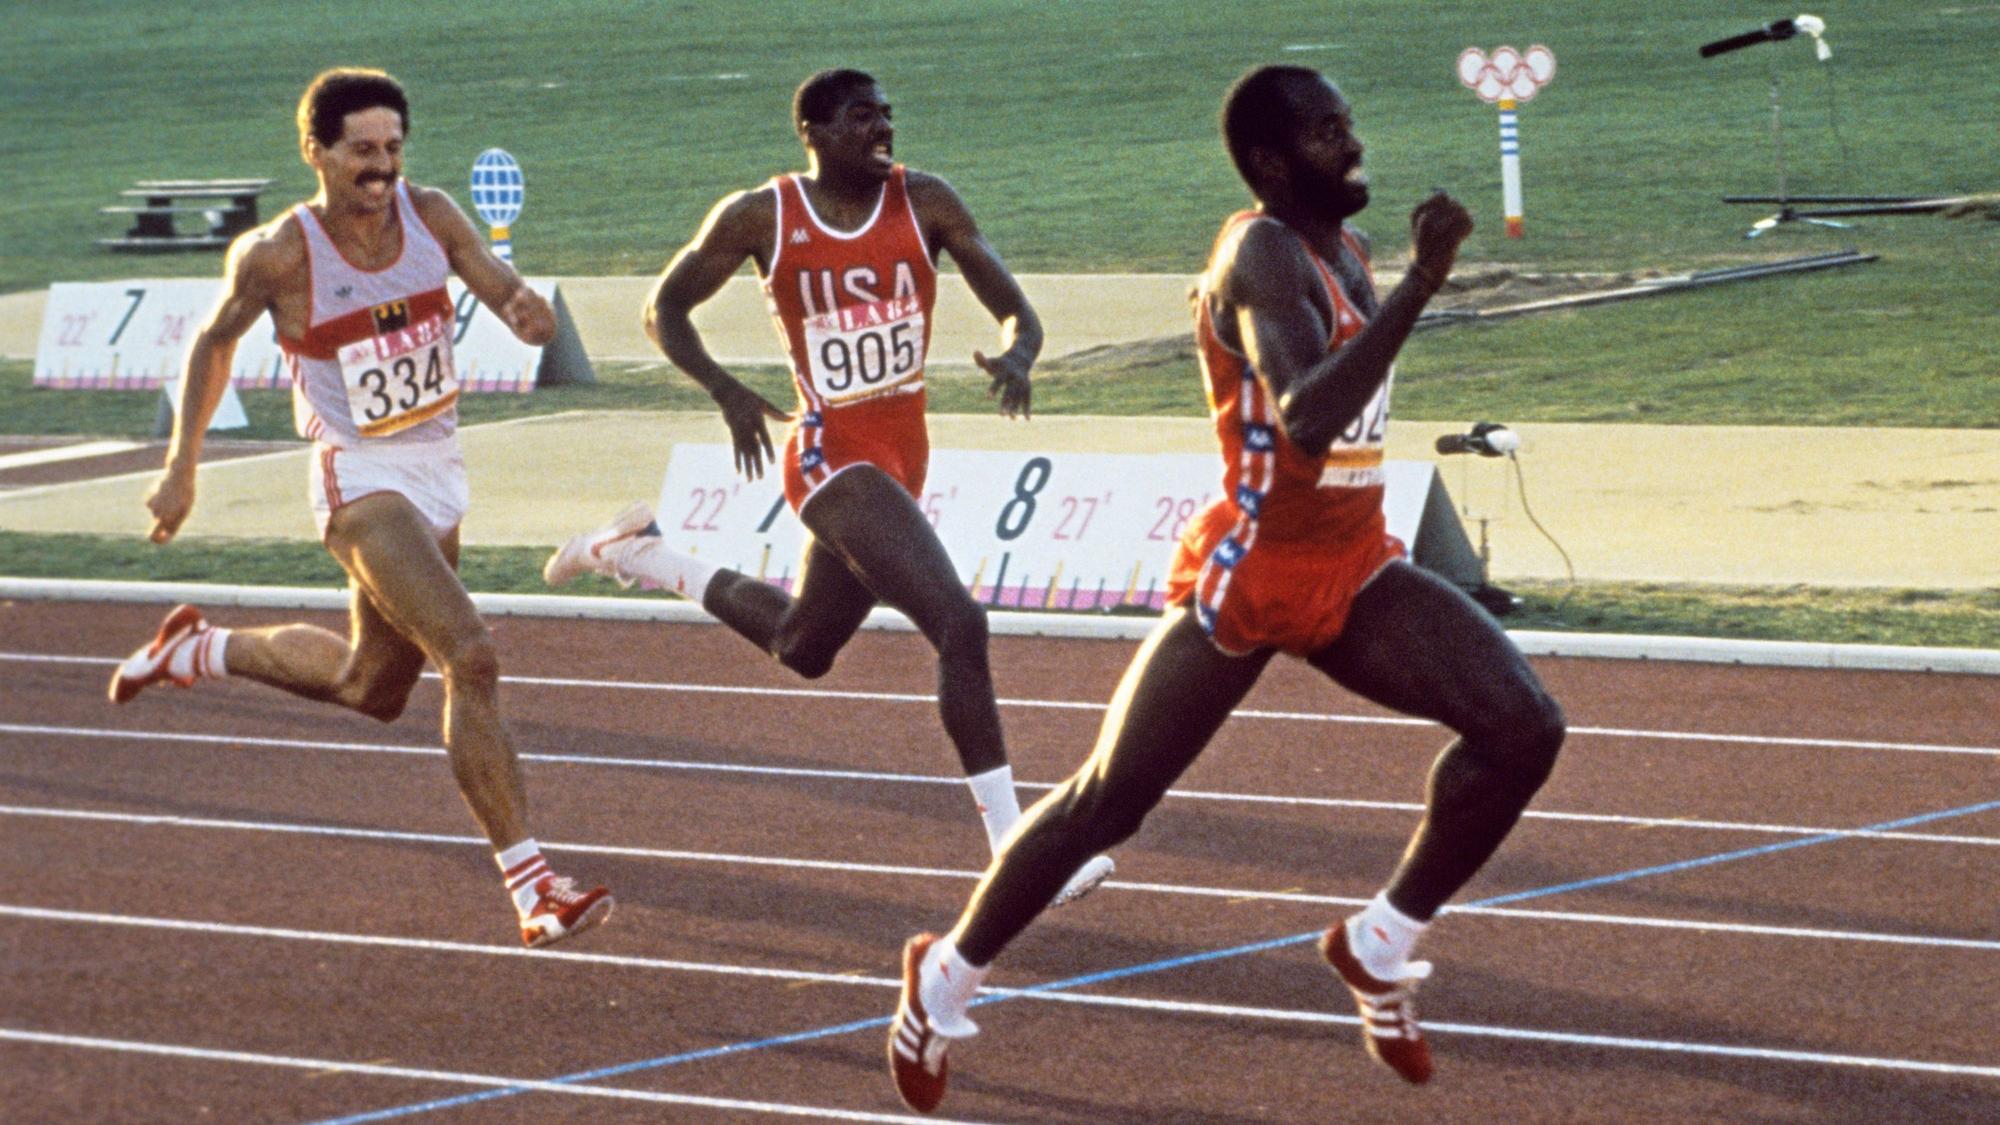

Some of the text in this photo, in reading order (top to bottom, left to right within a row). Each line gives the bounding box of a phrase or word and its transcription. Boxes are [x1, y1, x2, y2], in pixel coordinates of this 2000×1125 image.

[108, 288, 147, 346] 7
[359, 345, 445, 421] 334
[820, 320, 915, 392] 905
[996, 456, 1053, 541] 8
